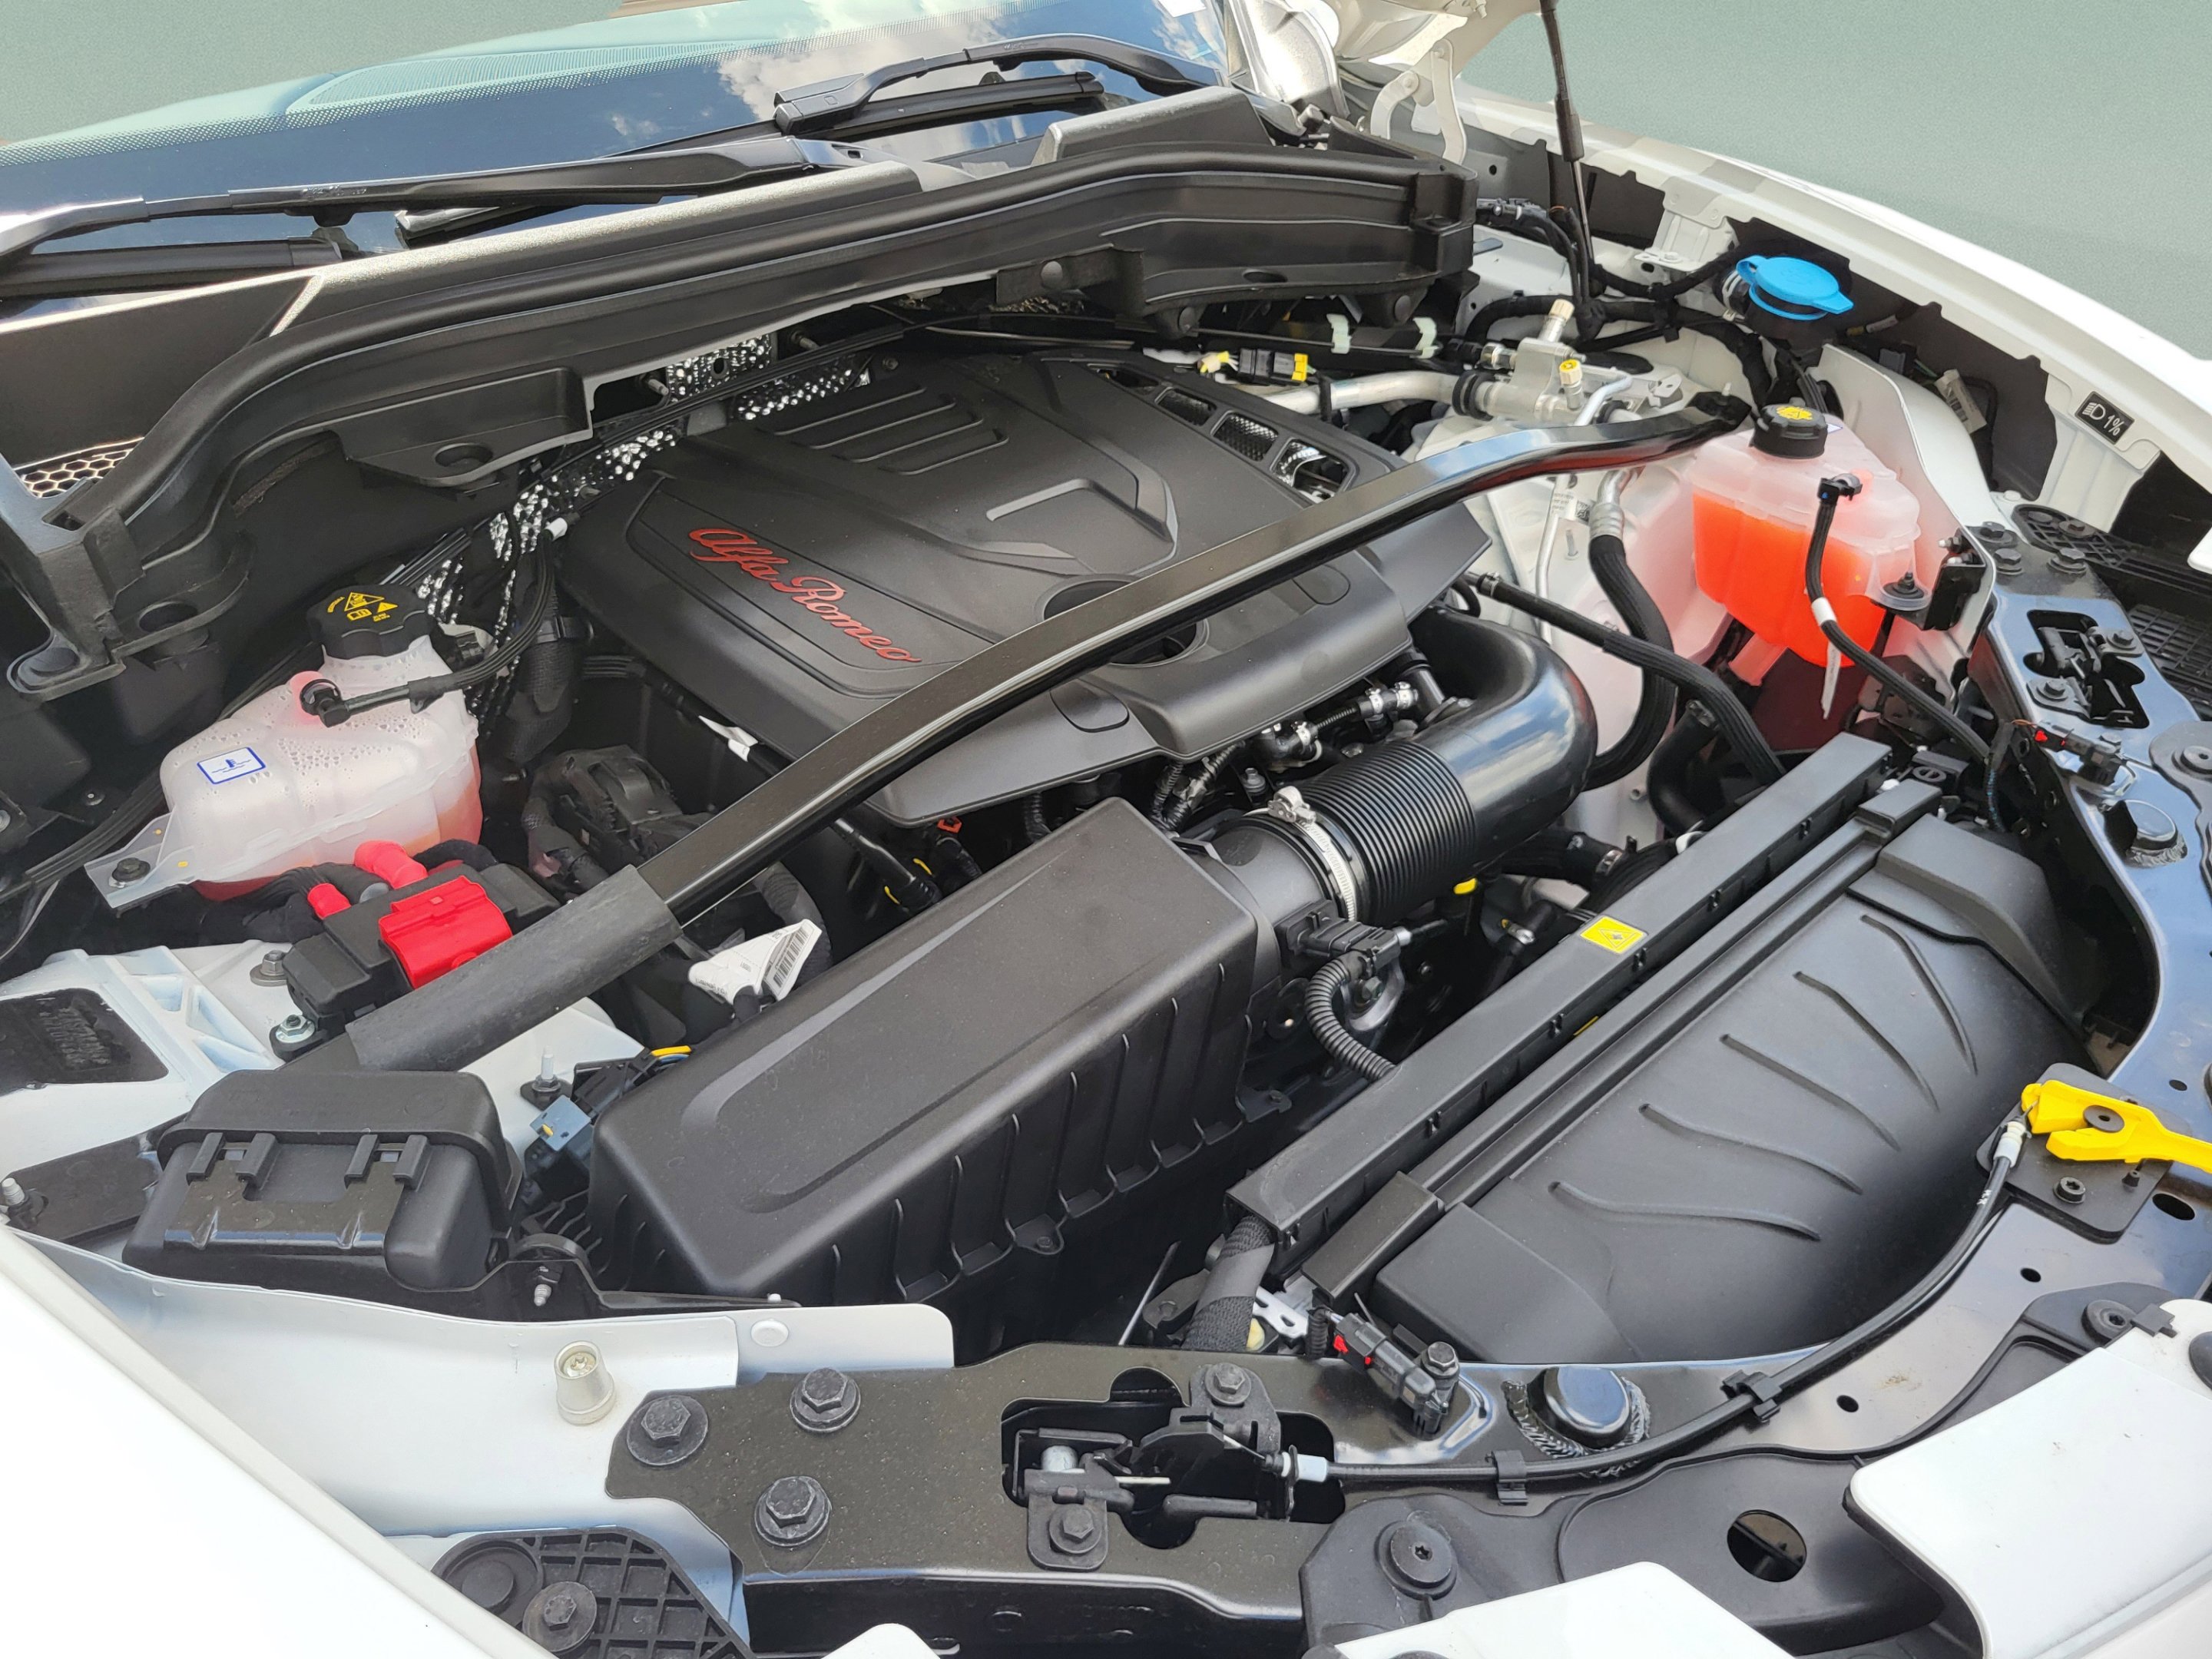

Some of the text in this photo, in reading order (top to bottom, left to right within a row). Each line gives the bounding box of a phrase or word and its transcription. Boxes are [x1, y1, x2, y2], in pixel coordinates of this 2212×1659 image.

[2104, 414, 2124, 436] 1%
[689, 528, 922, 662] Alfa Romeo
